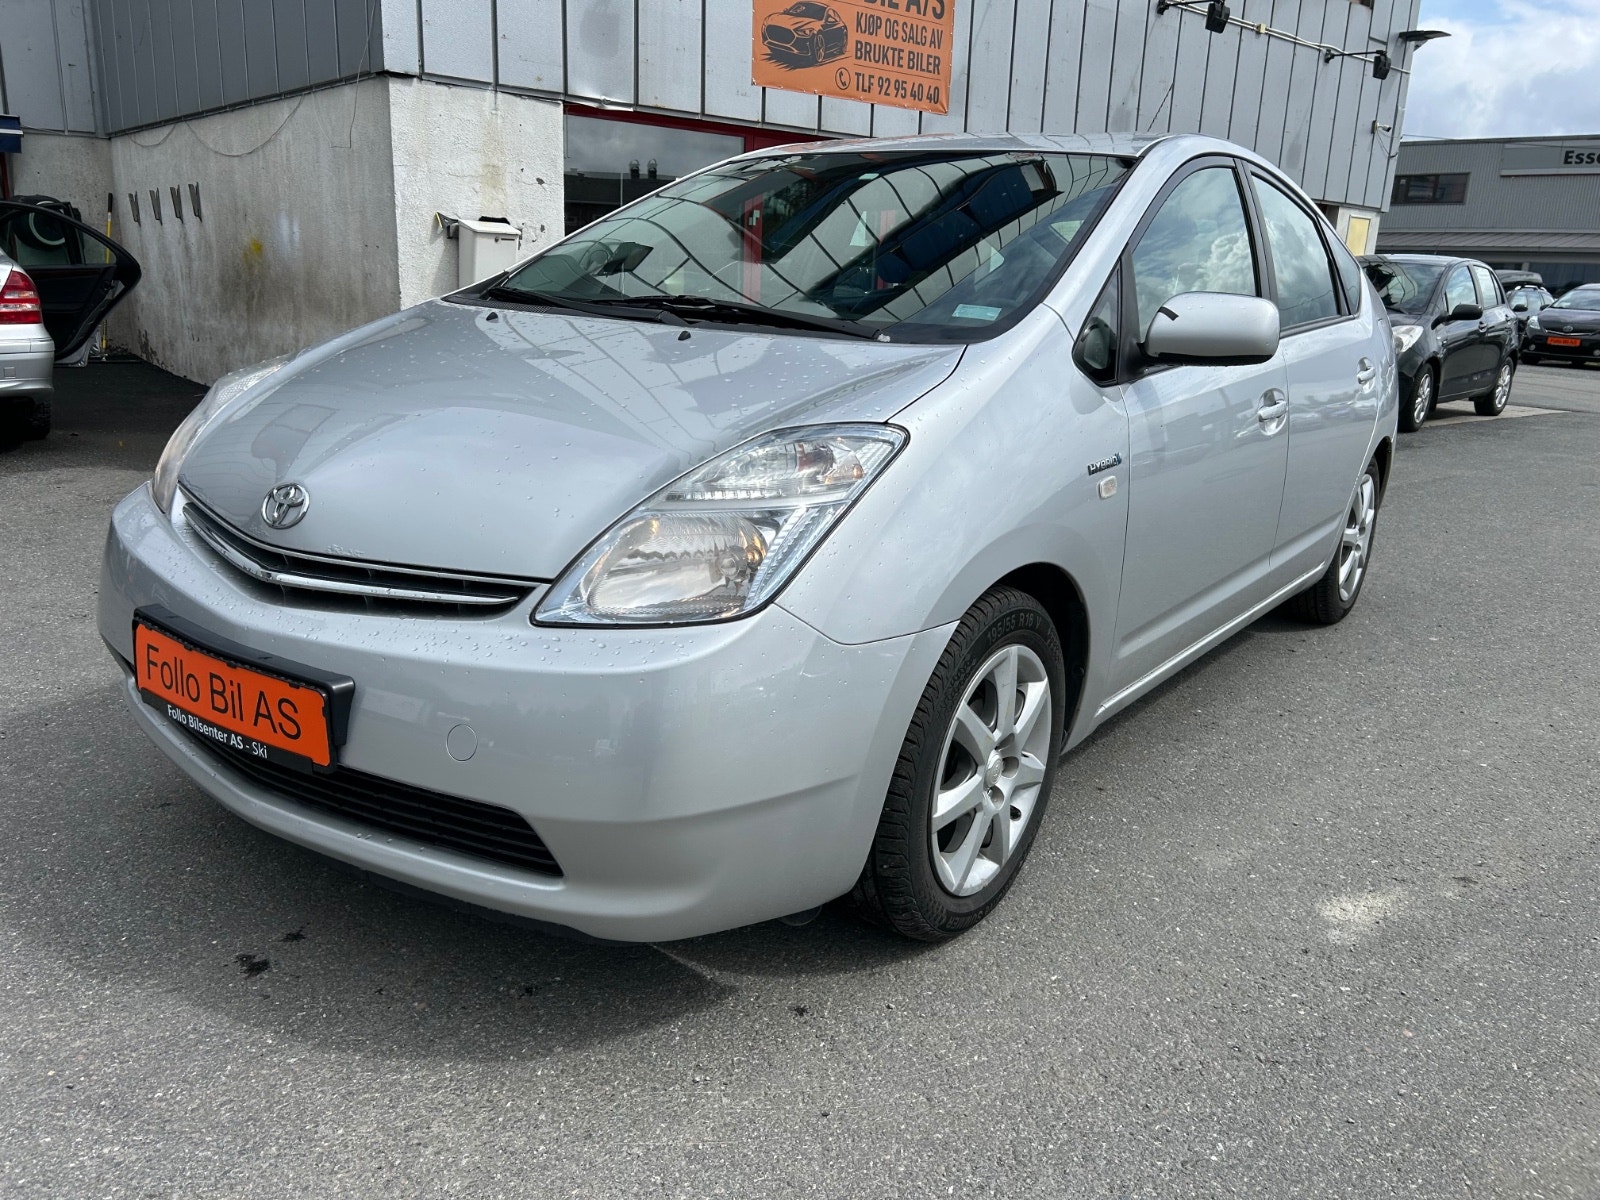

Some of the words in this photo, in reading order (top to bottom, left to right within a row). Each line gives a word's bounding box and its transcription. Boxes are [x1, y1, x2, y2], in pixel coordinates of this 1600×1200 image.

[856, 11, 882, 37] KJØP
[885, 18, 898, 41] OG
[901, 21, 927, 46] SALG
[929, 28, 943, 49] AV
[855, 40, 904, 68] BRUKTE
[907, 51, 941, 75] BILER
[855, 72, 874, 93] TLF
[877, 76, 891, 97] 92
[894, 79, 907, 99] 95
[910, 82, 923, 102] 40
[926, 85, 940, 105] 40
[146, 643, 201, 703] Follo
[209, 671, 245, 722] Bil
[253, 690, 302, 741] AS
[167, 704, 187, 725] Follo
[188, 714, 228, 743] Bilsenter
[230, 733, 244, 750] AS
[252, 741, 268, 759] Ski
